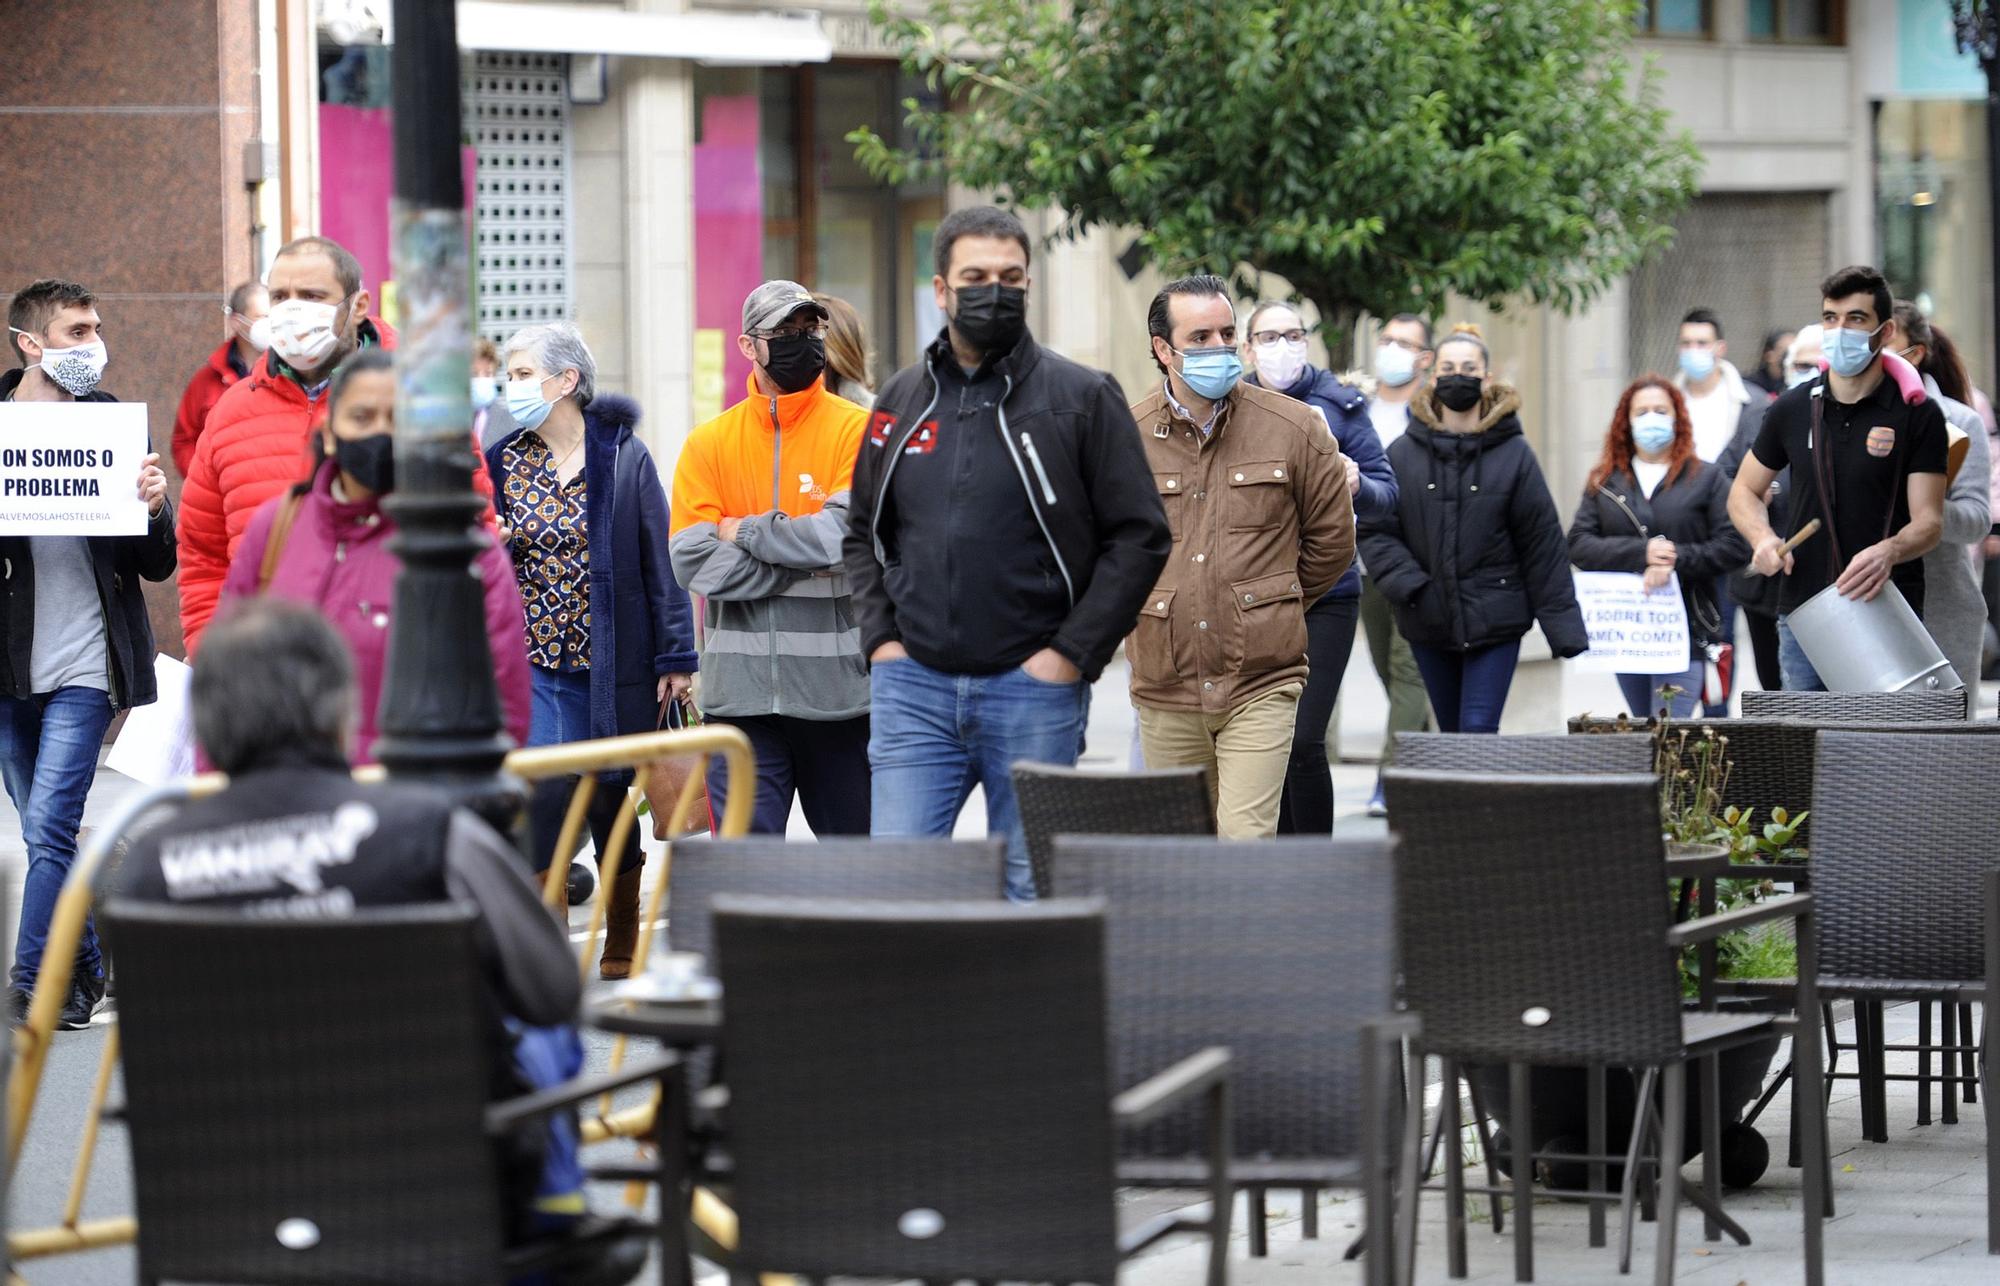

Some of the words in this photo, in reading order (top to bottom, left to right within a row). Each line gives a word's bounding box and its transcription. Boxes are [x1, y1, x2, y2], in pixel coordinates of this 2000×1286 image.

[0, 448, 27, 467] ON
[32, 448, 97, 467] SOMOS
[102, 449, 113, 467] O
[4, 478, 100, 497] PROBLEMA
[0, 512, 111, 521] ALVEMOSLAHOSTELERIA
[1587, 628, 1624, 642] AMÉN
